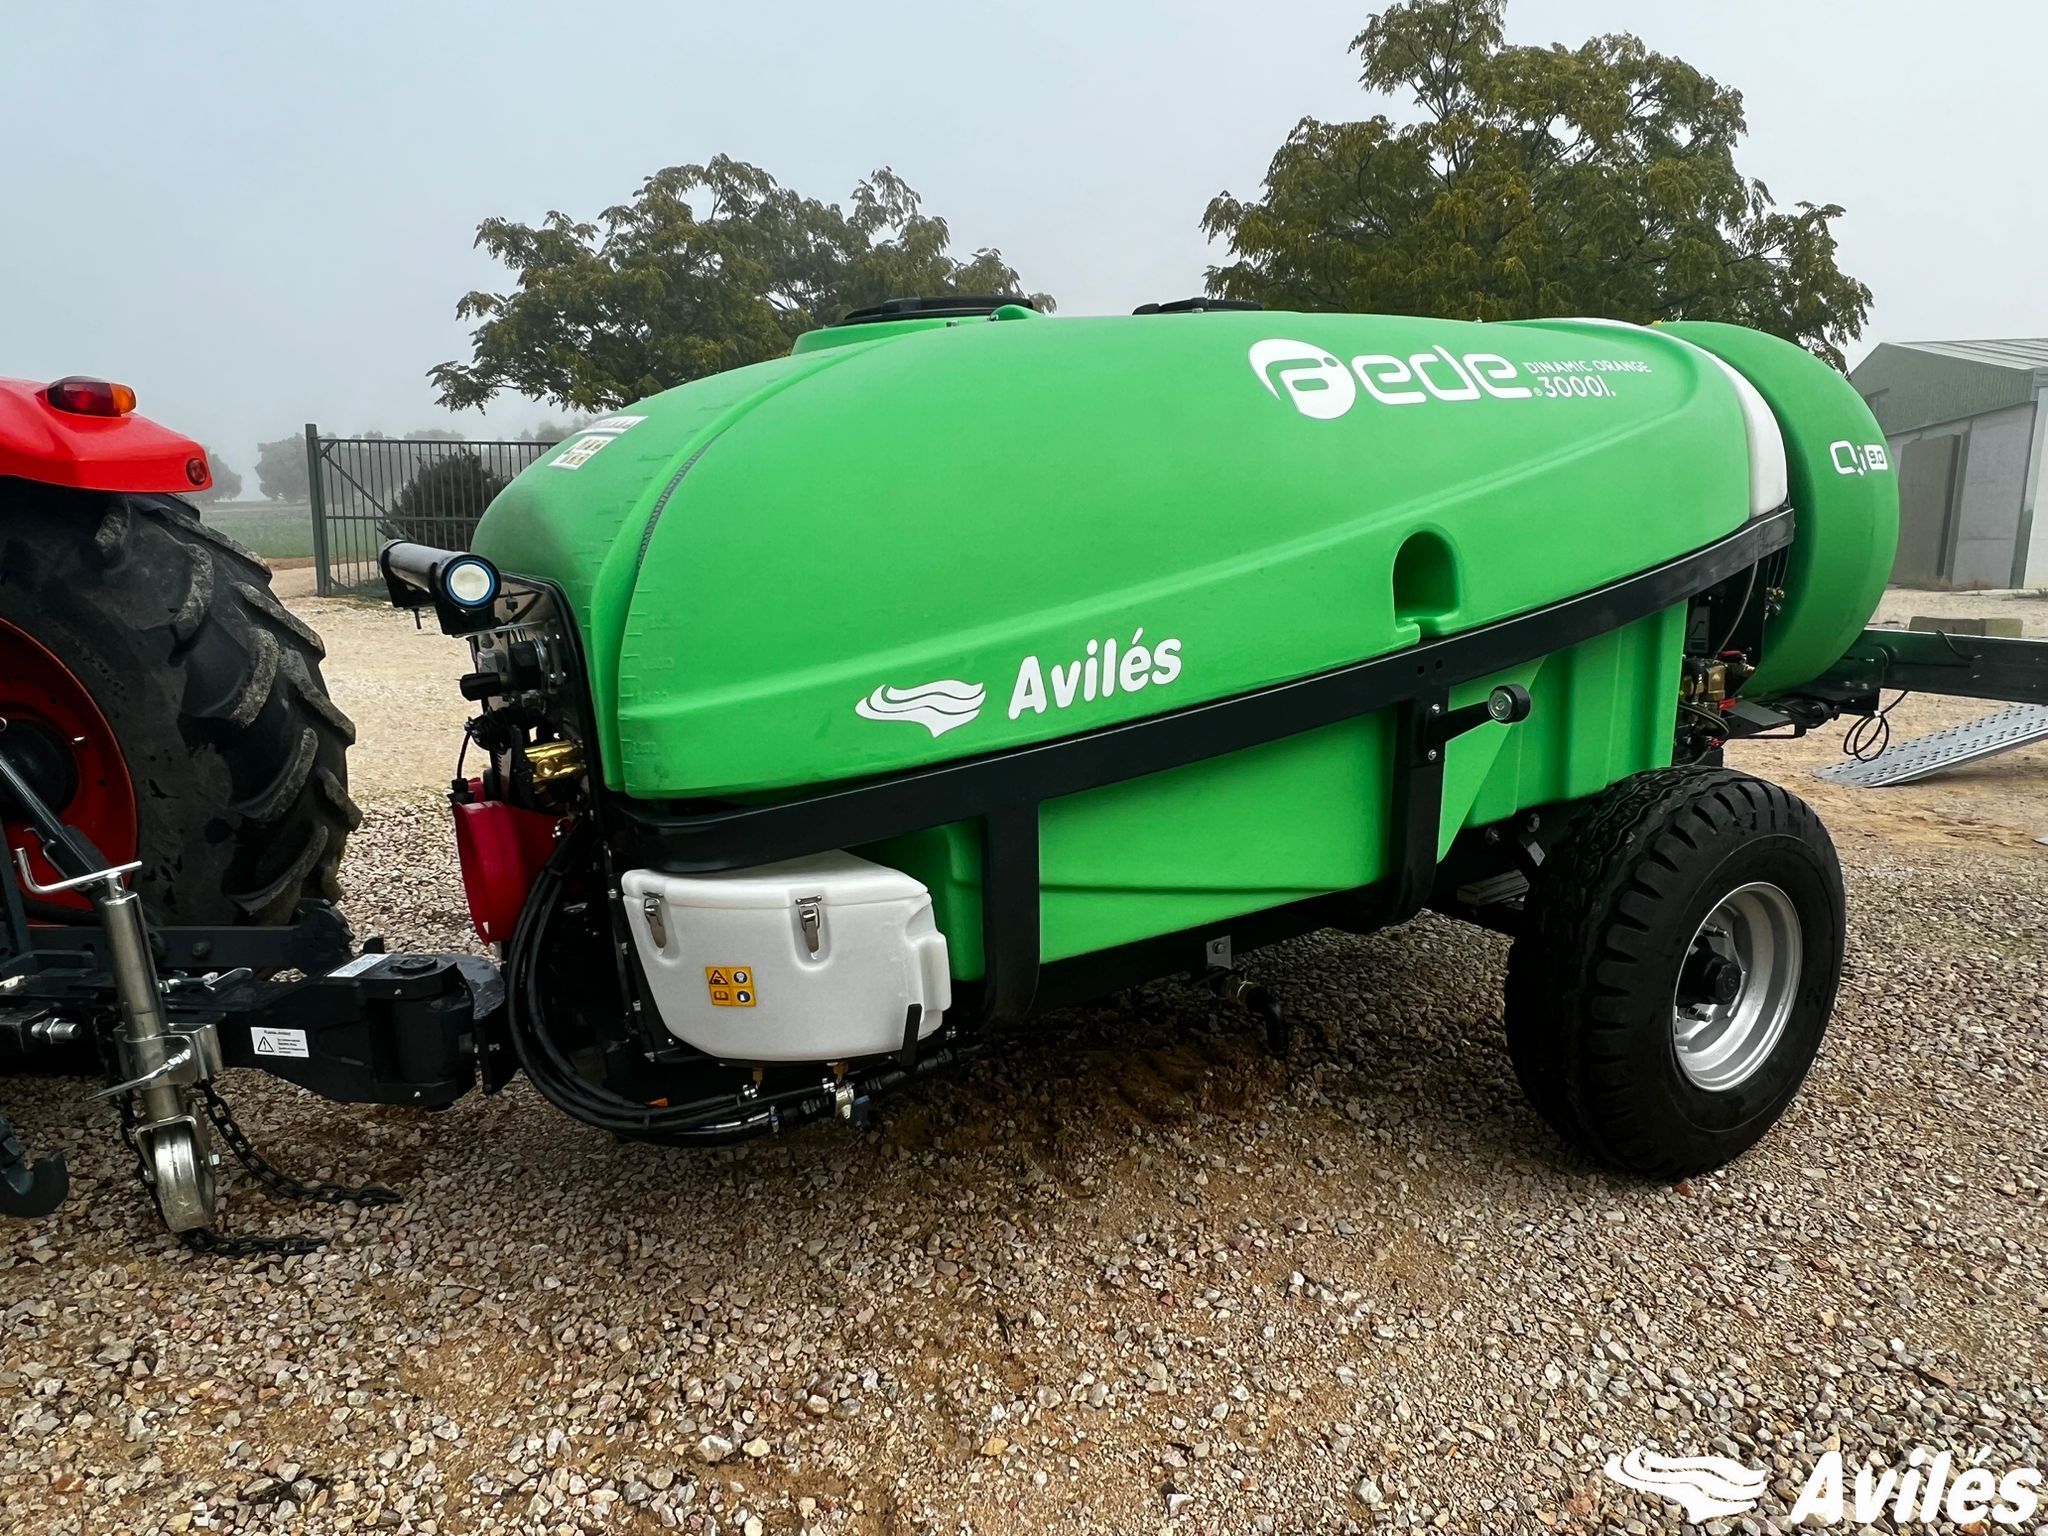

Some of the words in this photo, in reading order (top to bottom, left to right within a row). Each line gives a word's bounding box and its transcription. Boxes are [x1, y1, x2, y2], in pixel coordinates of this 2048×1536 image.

[1522, 360, 1594, 374] DINAMIC
[1591, 360, 1653, 373] ORANGE
[1007, 626, 1183, 721] Avilés
